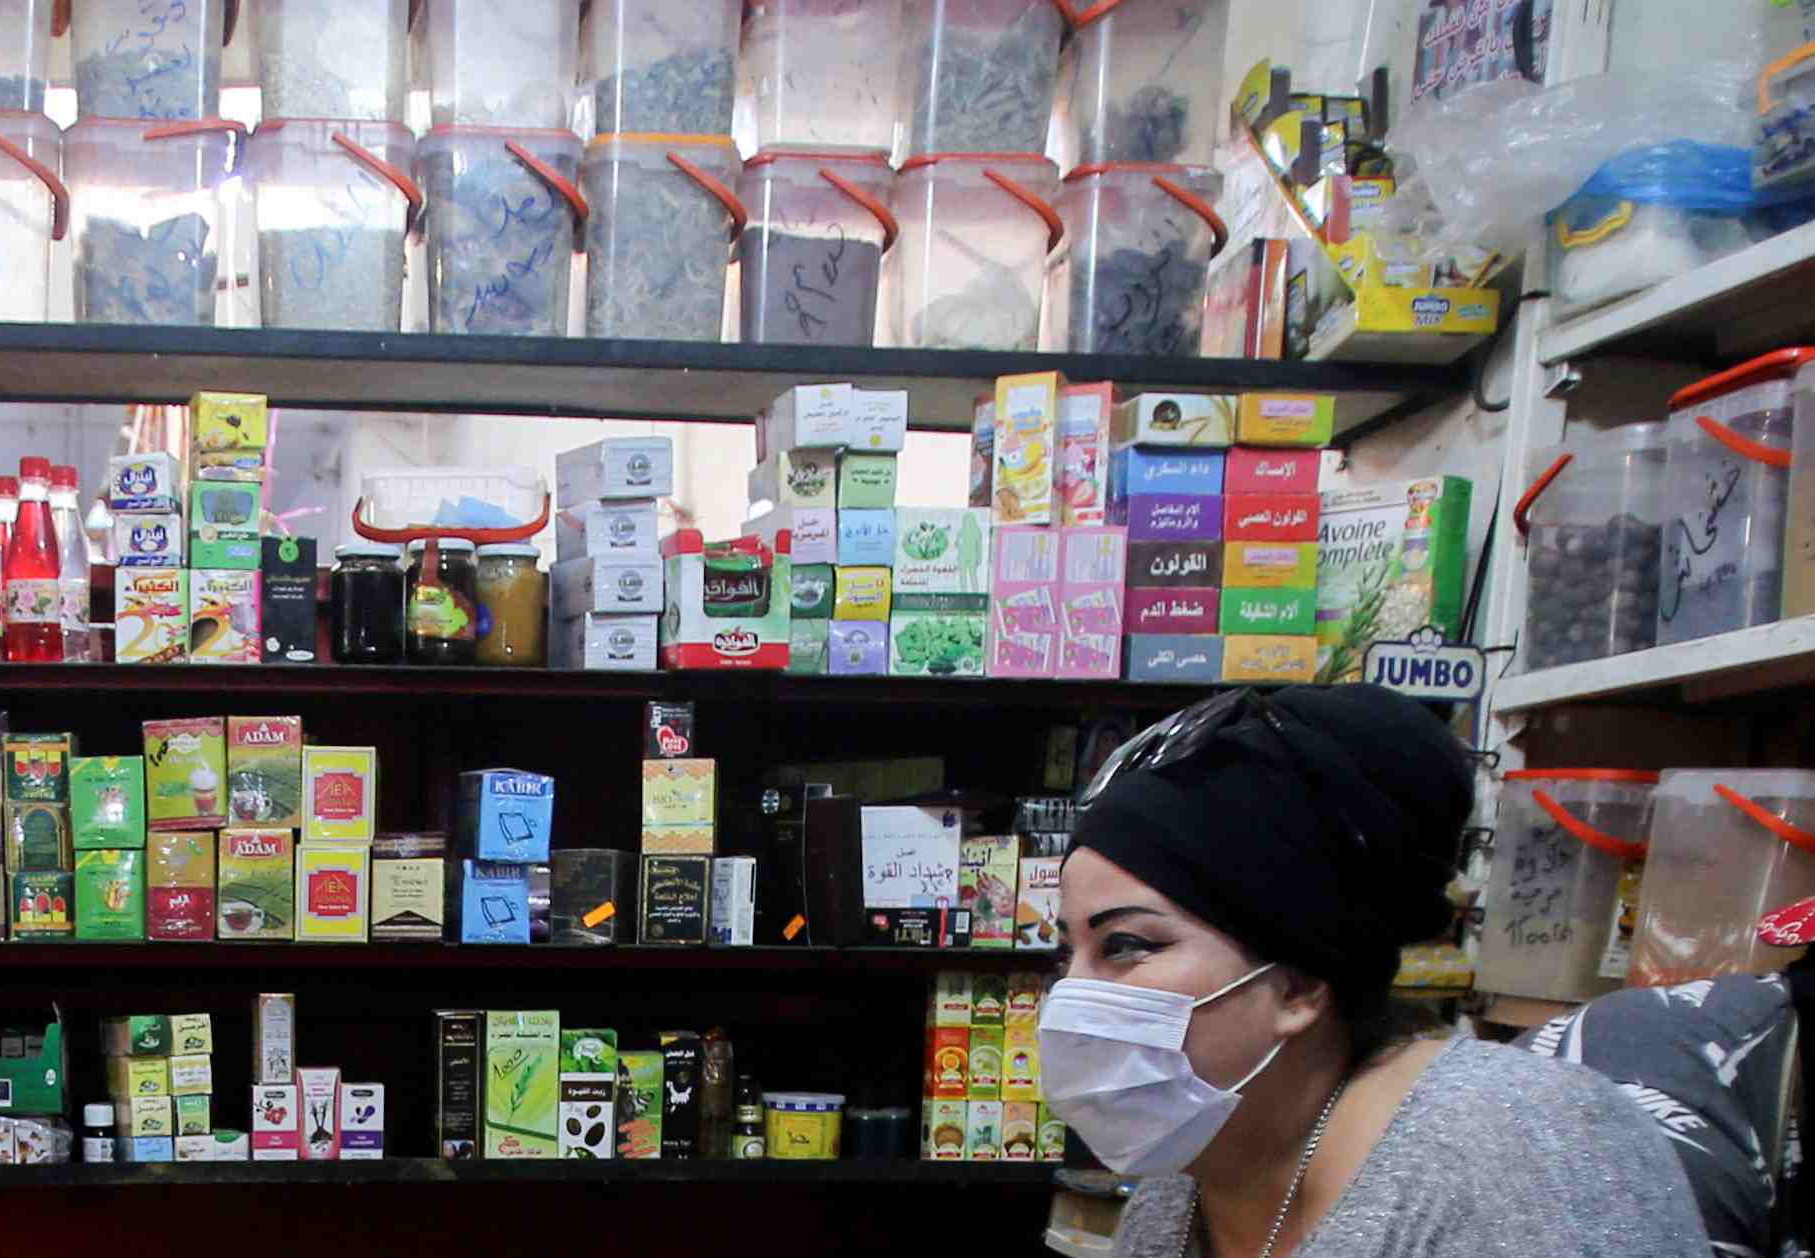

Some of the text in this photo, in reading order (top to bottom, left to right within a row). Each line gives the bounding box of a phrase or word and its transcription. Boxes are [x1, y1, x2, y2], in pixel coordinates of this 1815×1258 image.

[1318, 517, 1387, 544] Avoine
[1150, 552, 1207, 576] القولون
[1318, 540, 1394, 571] omplète
[1140, 599, 1204, 622] ضغط الدم
[1373, 656, 1474, 689] JUMBO
[242, 729, 285, 744] ADAM
[494, 777, 543, 796] KABIR
[234, 842, 277, 858] ADAM
[866, 860, 903, 885] القوة
